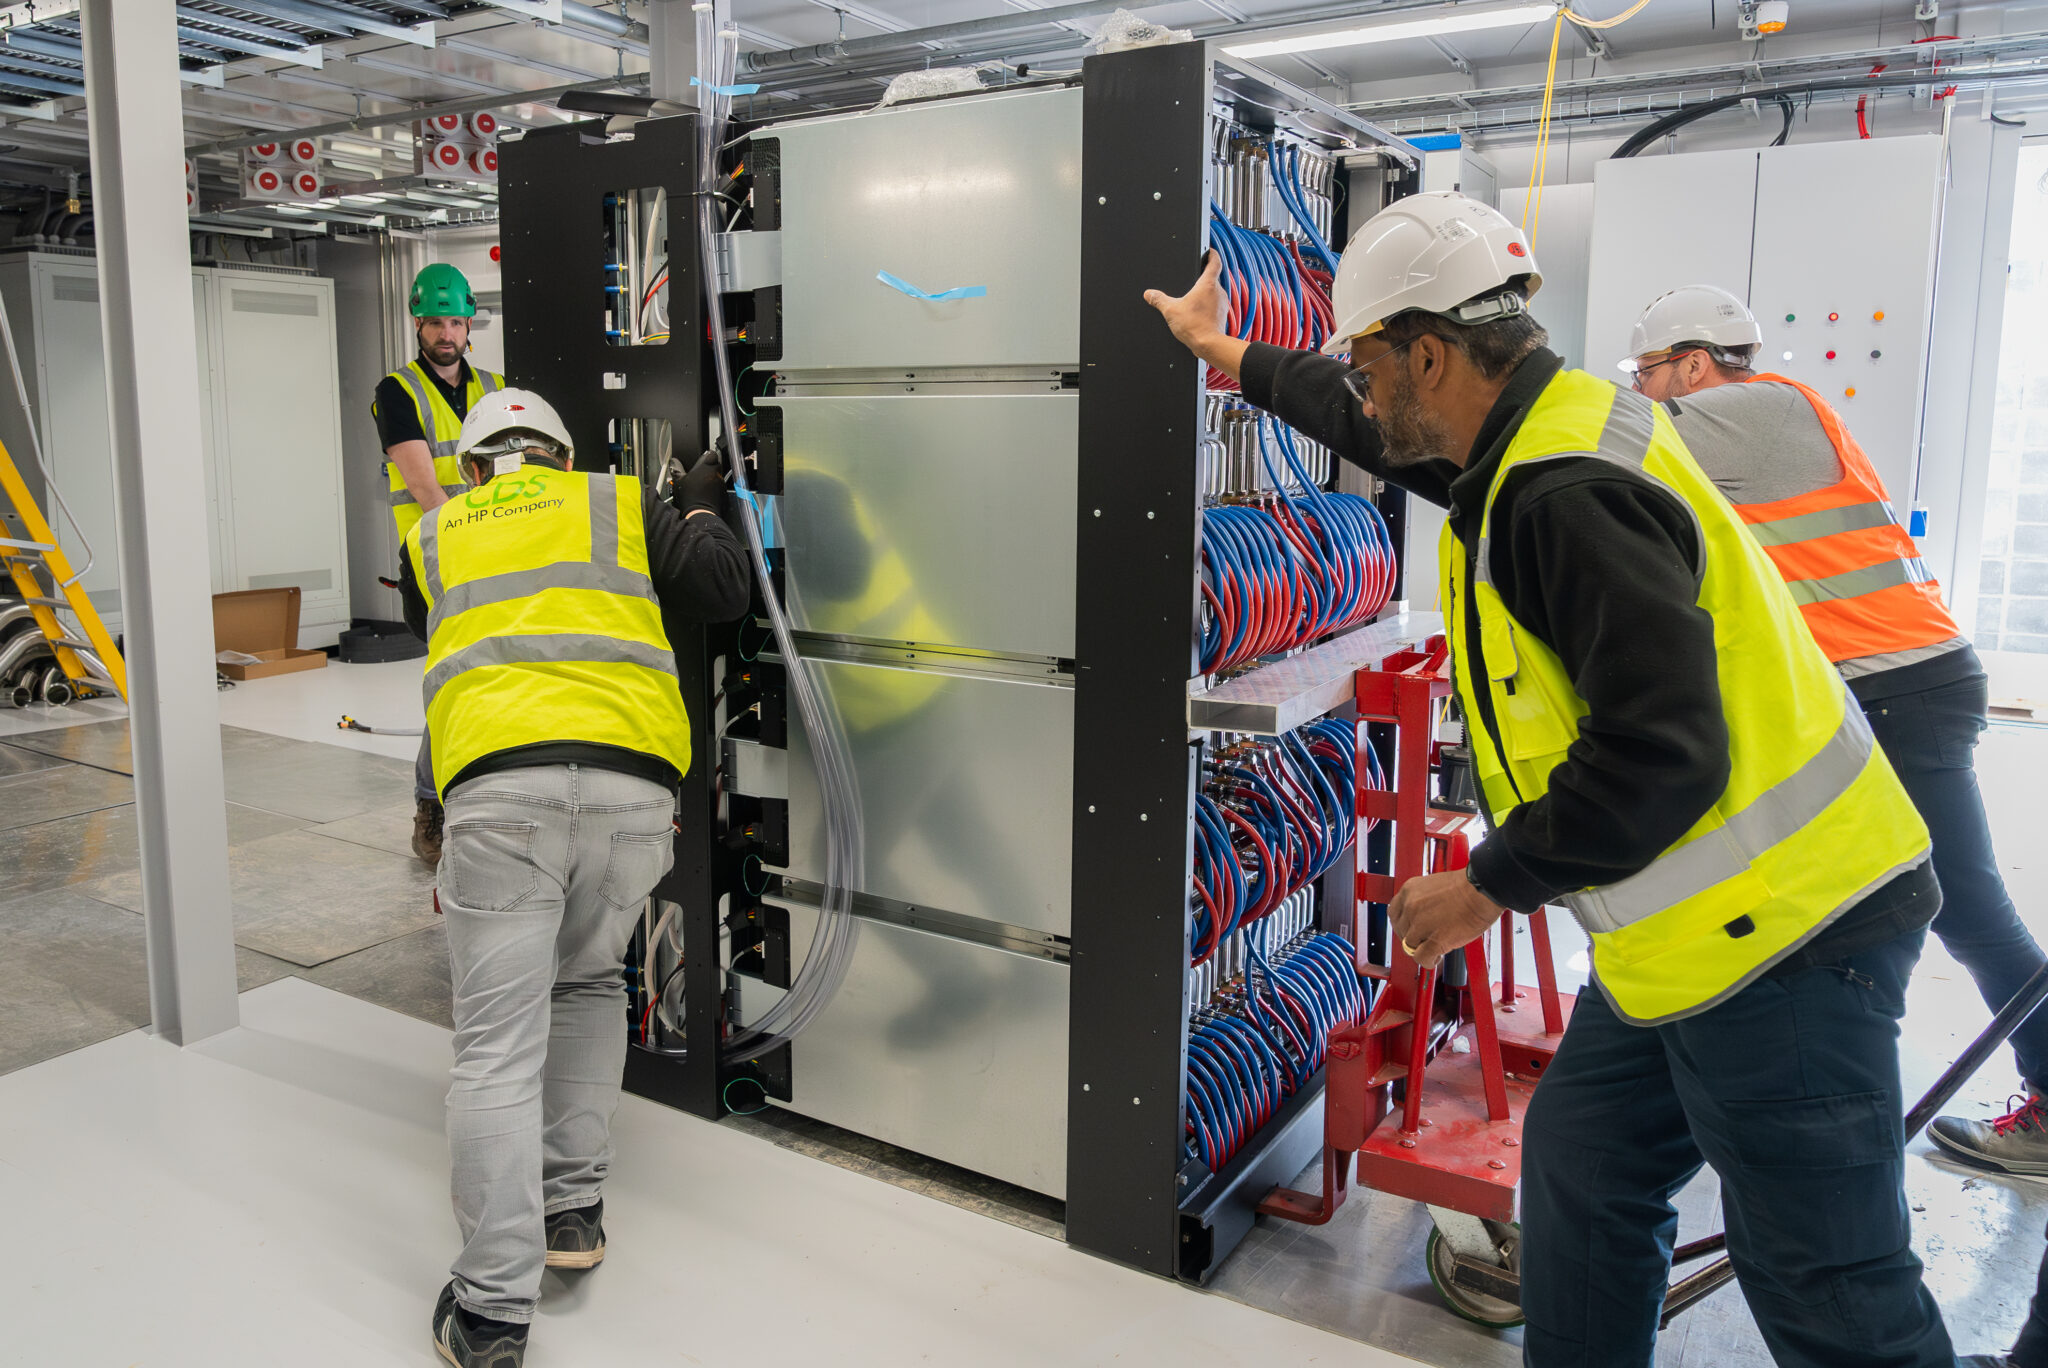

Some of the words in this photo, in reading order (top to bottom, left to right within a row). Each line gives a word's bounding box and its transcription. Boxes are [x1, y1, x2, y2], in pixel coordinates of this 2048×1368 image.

[465, 474, 550, 509] CDS
[444, 518, 463, 532] An
[467, 509, 488, 523] HP
[492, 497, 565, 518] Company
